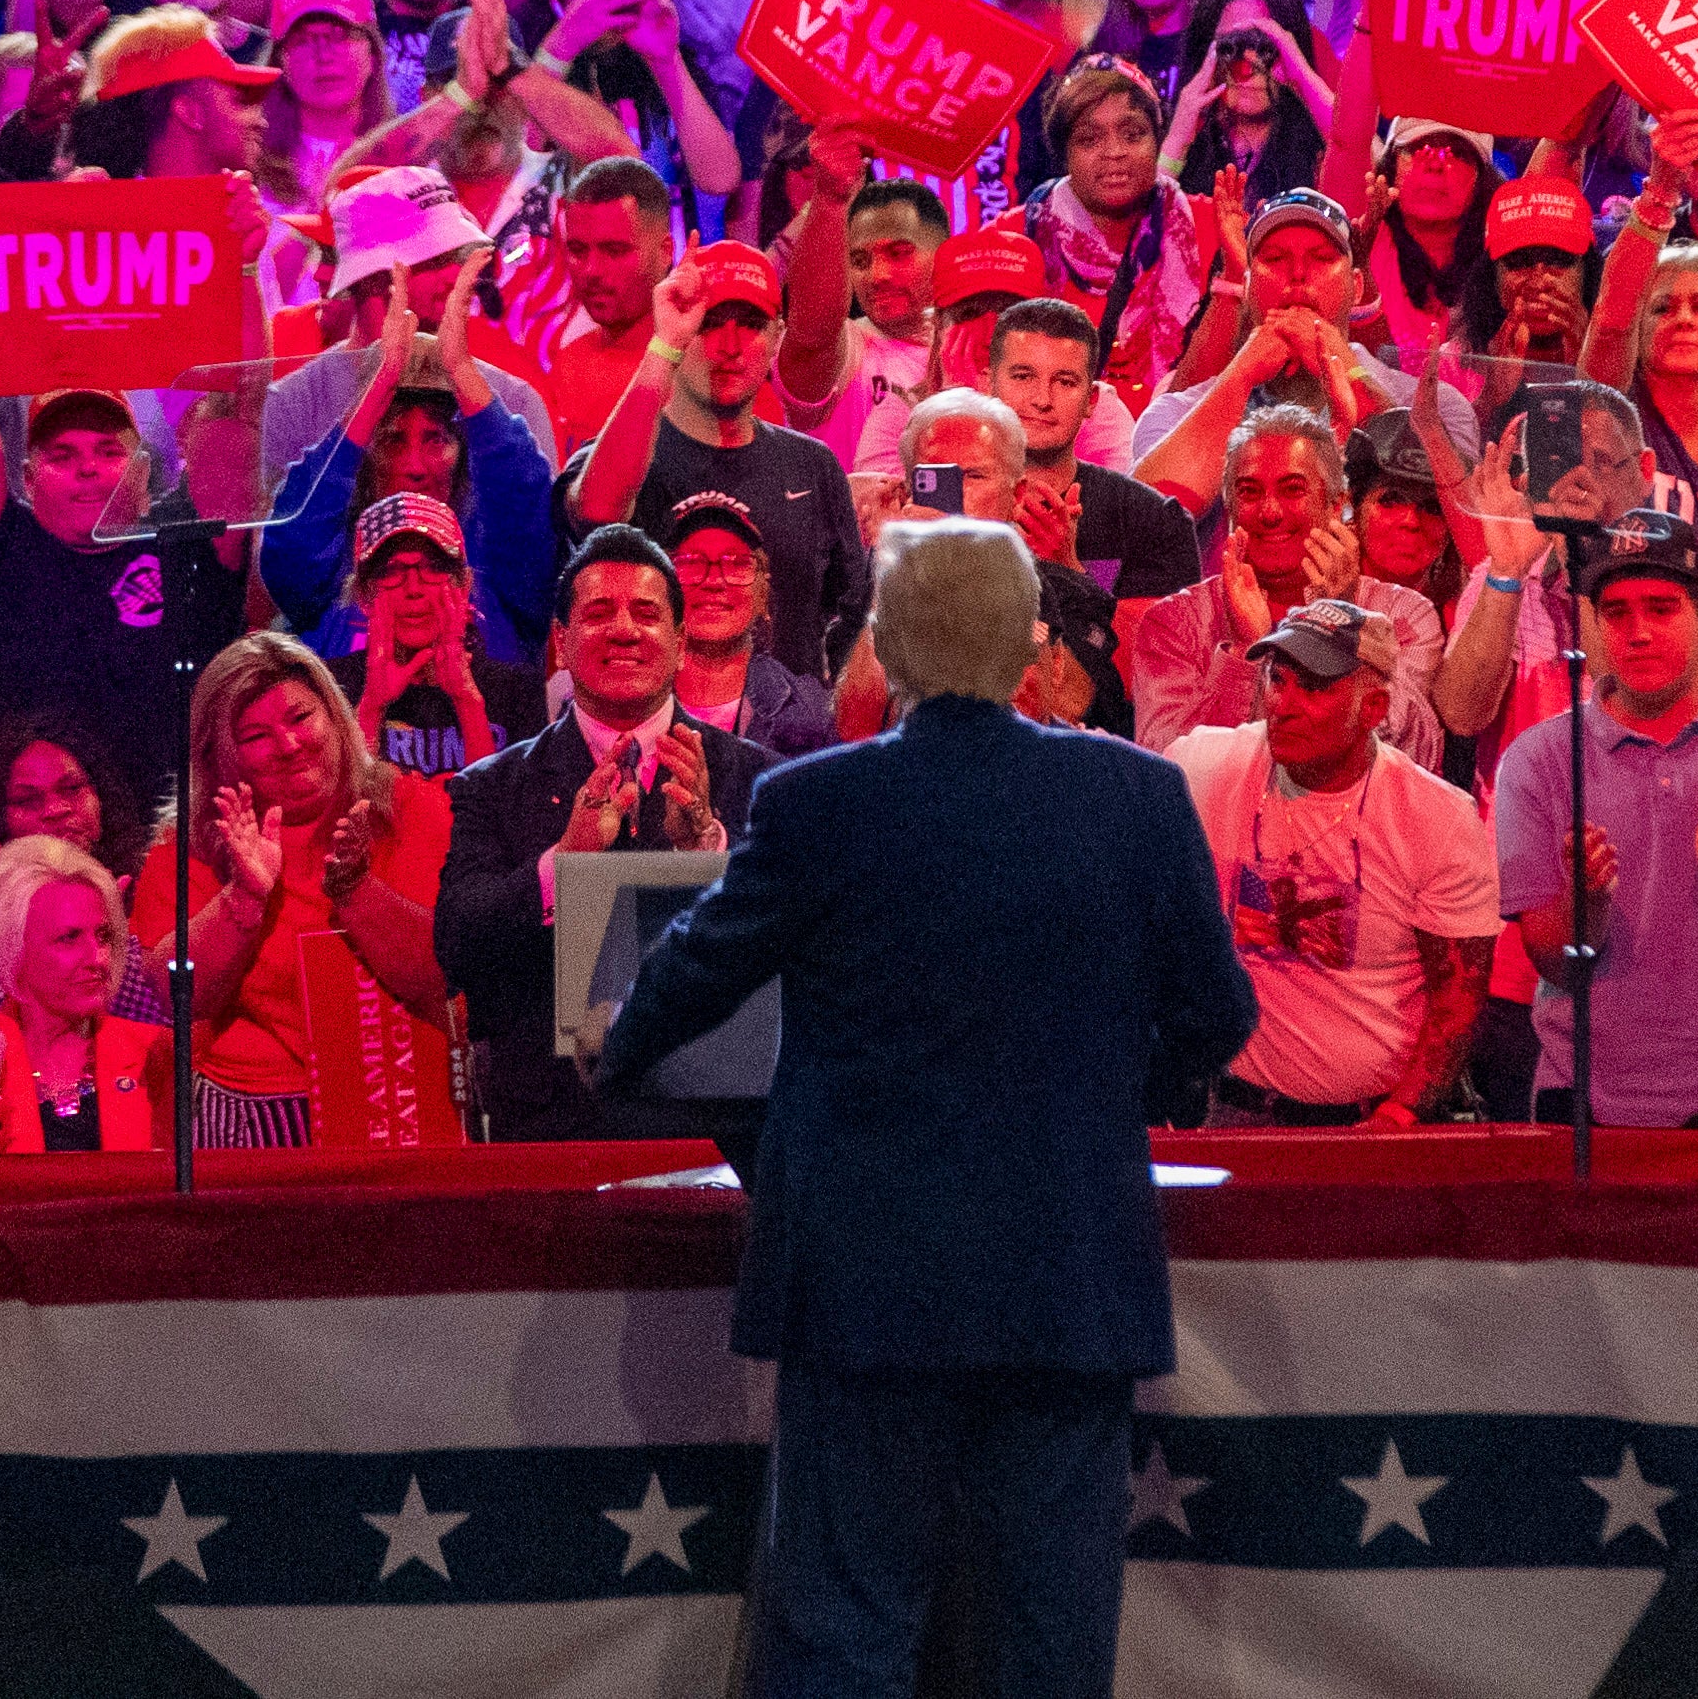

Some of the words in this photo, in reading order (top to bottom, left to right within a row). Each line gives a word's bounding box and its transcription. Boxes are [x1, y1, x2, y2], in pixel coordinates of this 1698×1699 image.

[1627, 11, 1660, 43] MAKE
[794, 0, 967, 128] VANCE
[1501, 206, 1533, 223] GREAT
[1540, 205, 1574, 219] AGAIN
[1529, 192, 1575, 207] AMERICA
[673, 489, 751, 515] TRUMP
[356, 963, 389, 1104] AMERIC
[392, 1078, 420, 1147] EAT
